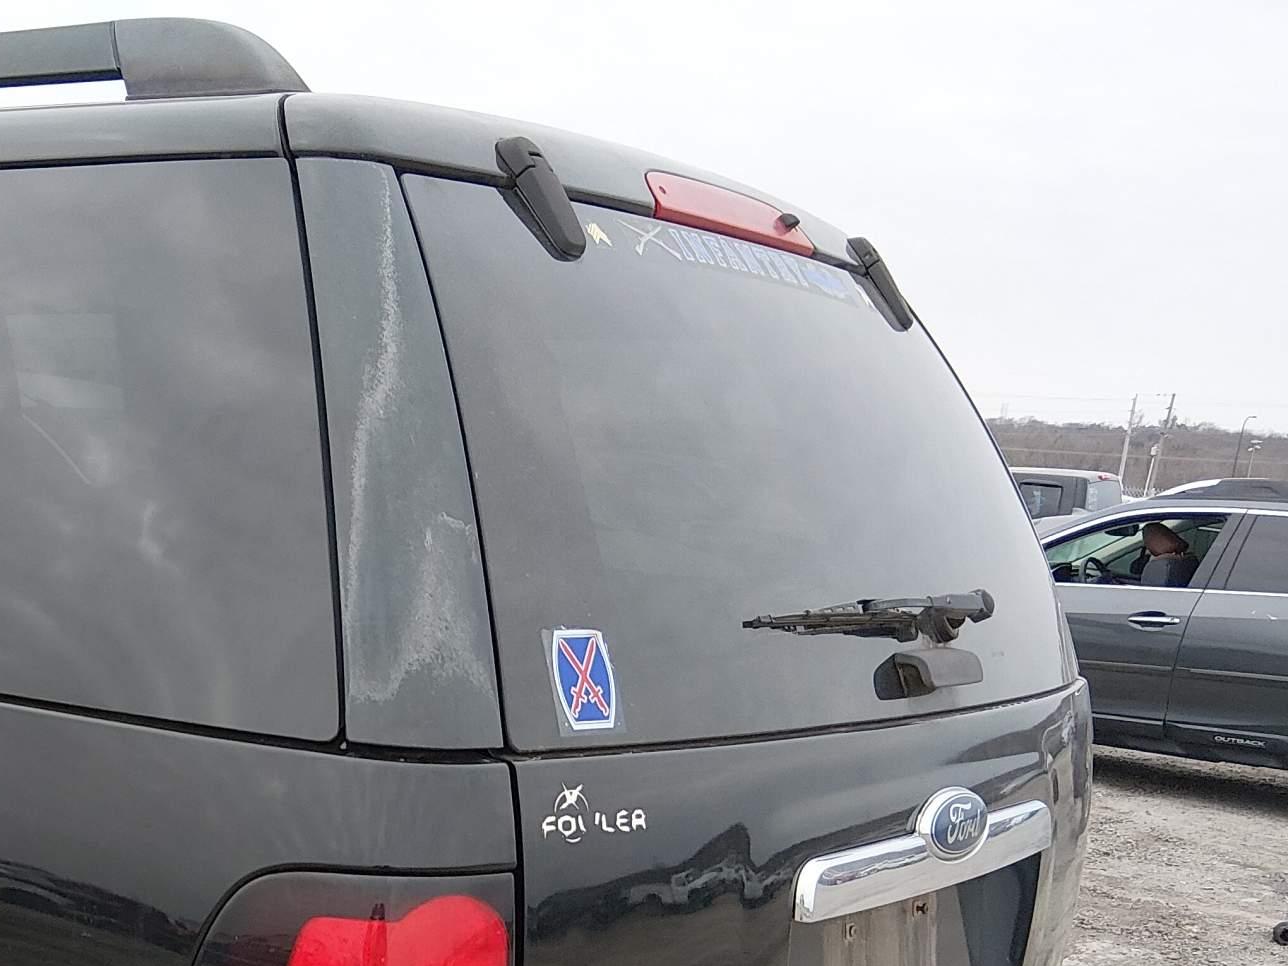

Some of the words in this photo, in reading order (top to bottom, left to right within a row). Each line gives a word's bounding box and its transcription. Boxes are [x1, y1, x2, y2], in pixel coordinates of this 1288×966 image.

[668, 228, 809, 287] INFANTRY
[1214, 735, 1266, 749] OUTBACK
[947, 802, 981, 845] Ford
